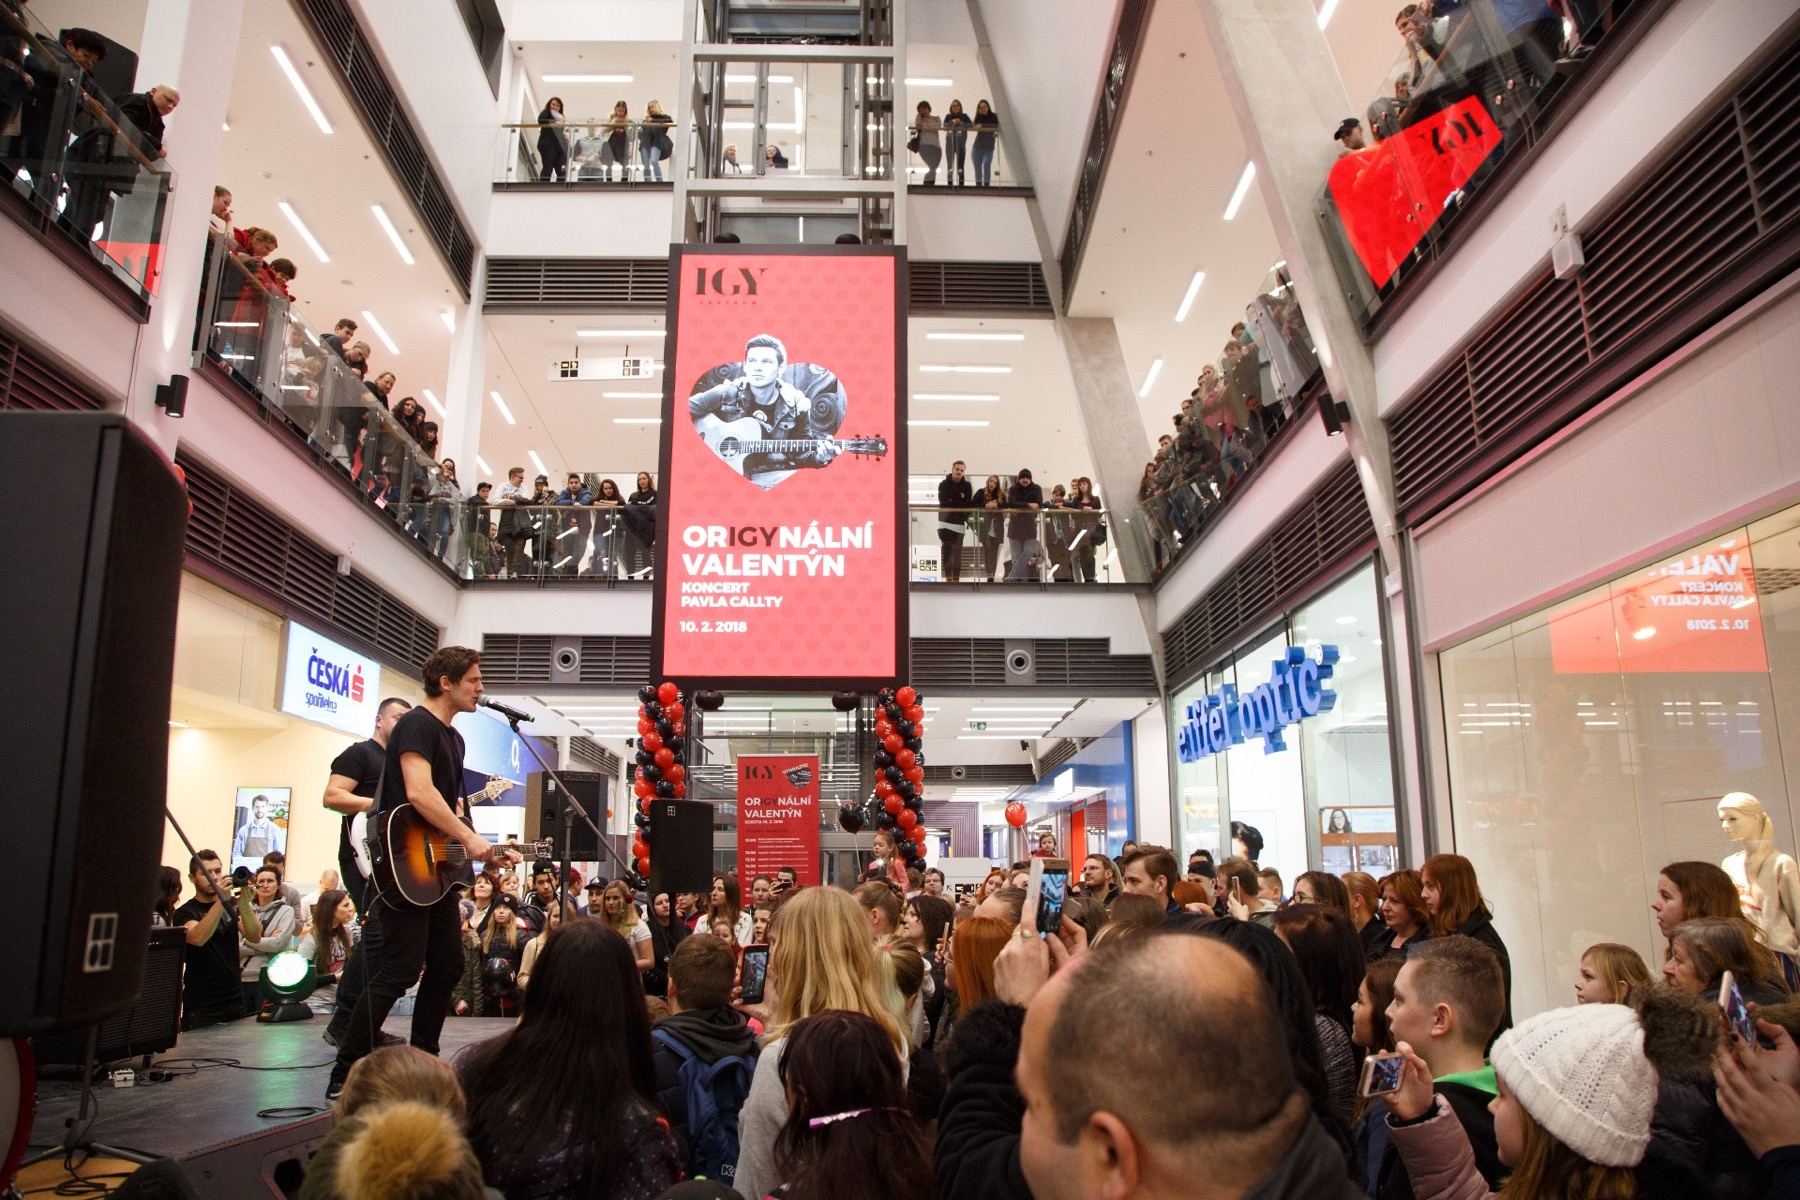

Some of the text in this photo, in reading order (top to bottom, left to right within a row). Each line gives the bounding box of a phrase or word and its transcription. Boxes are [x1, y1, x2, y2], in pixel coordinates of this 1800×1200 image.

[696, 268, 768, 295] IGY
[682, 520, 874, 548] ORIGYNÁLNÍ
[682, 548, 845, 577] VALENTÝN
[681, 582, 750, 594] KONCERT
[681, 596, 783, 608] PAVLA CALLTY
[679, 621, 747, 633] 10. 2. 2018
[307, 647, 350, 698] ČESKÁ
[1177, 646, 1330, 764] eiffel optic
[745, 765, 776, 780] IGY
[744, 795, 812, 806] ORIGYNÁLNÍ
[744, 807, 802, 818] VALENTÝN
